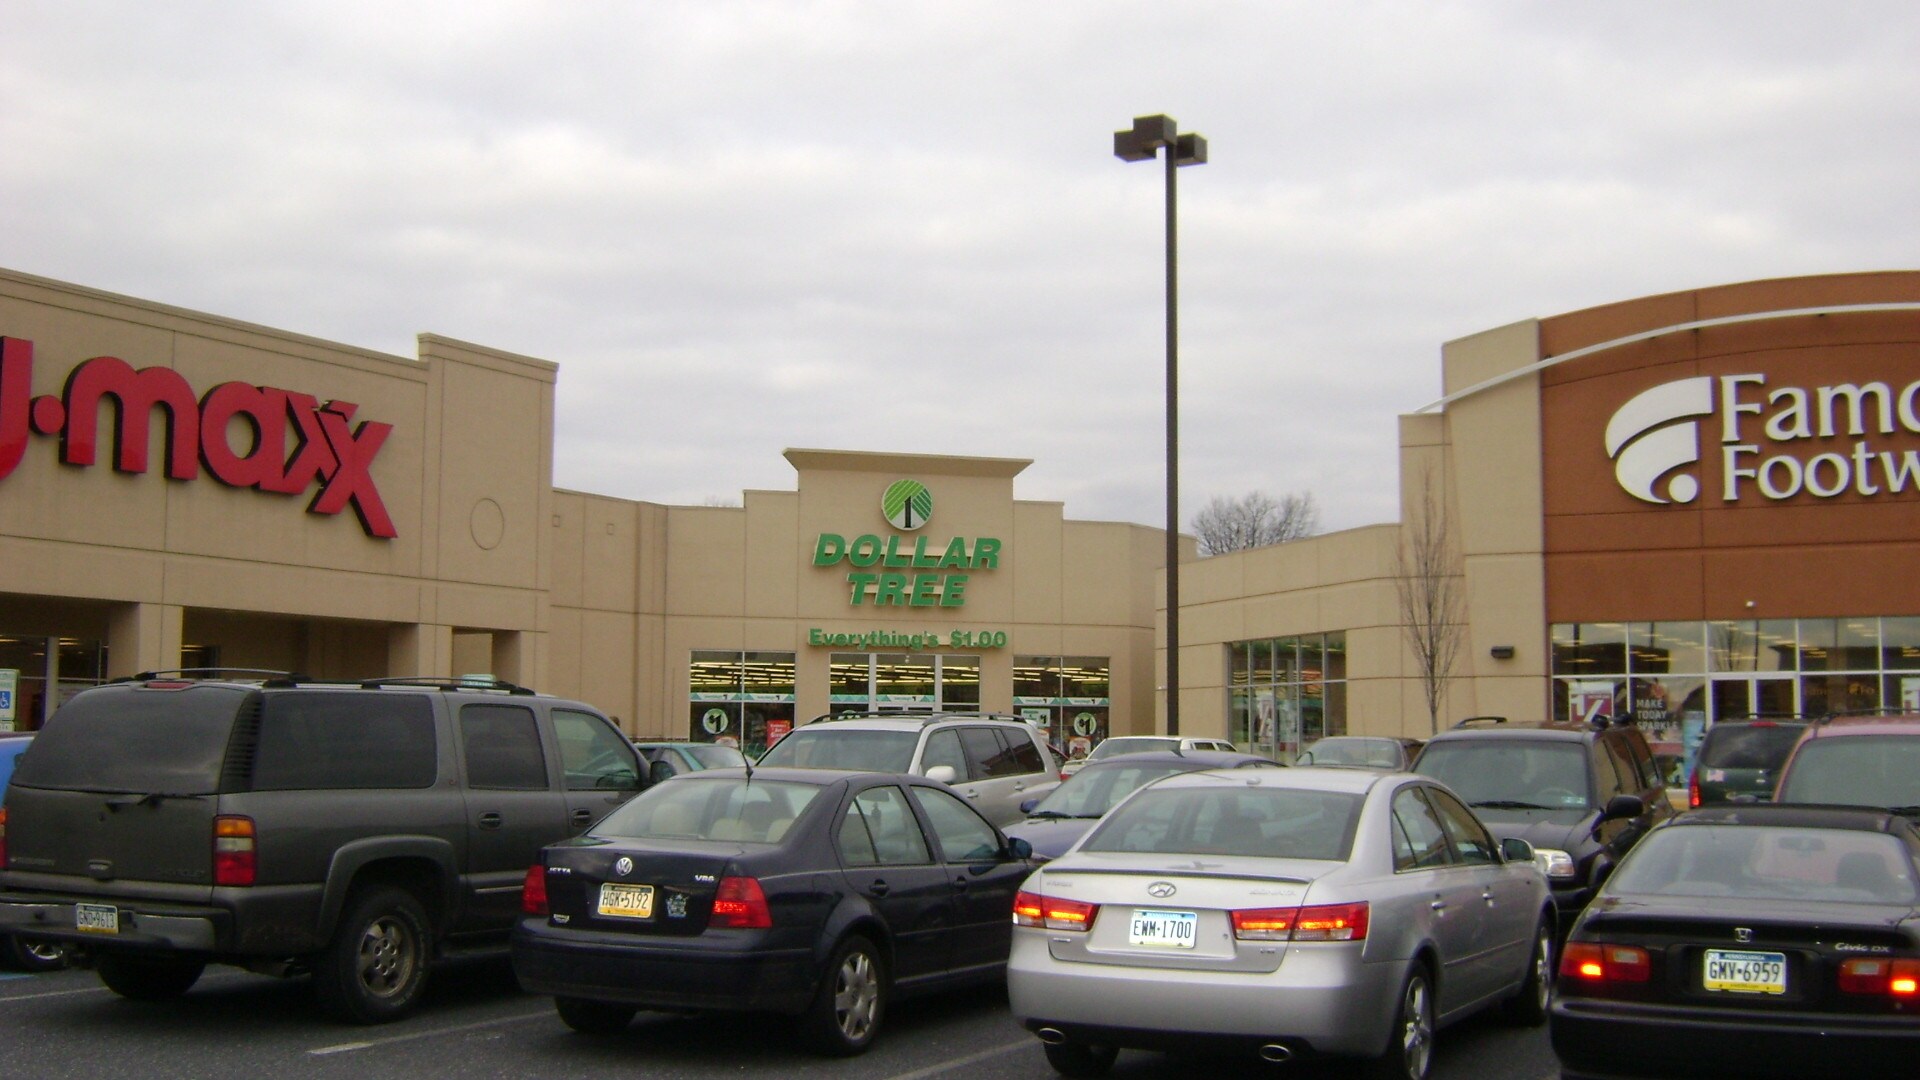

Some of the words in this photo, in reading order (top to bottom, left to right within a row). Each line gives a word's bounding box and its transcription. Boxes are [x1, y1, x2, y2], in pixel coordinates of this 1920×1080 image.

[812, 533, 1002, 569] DOLLAR
[847, 572, 969, 607] TREE
[808, 628, 939, 650] Everything's
[950, 629, 1007, 649] $1.00
[1636, 699, 1663, 709] MAKE
[1636, 710, 1667, 720] TODAY
[1835, 942, 1868, 952] Civic
